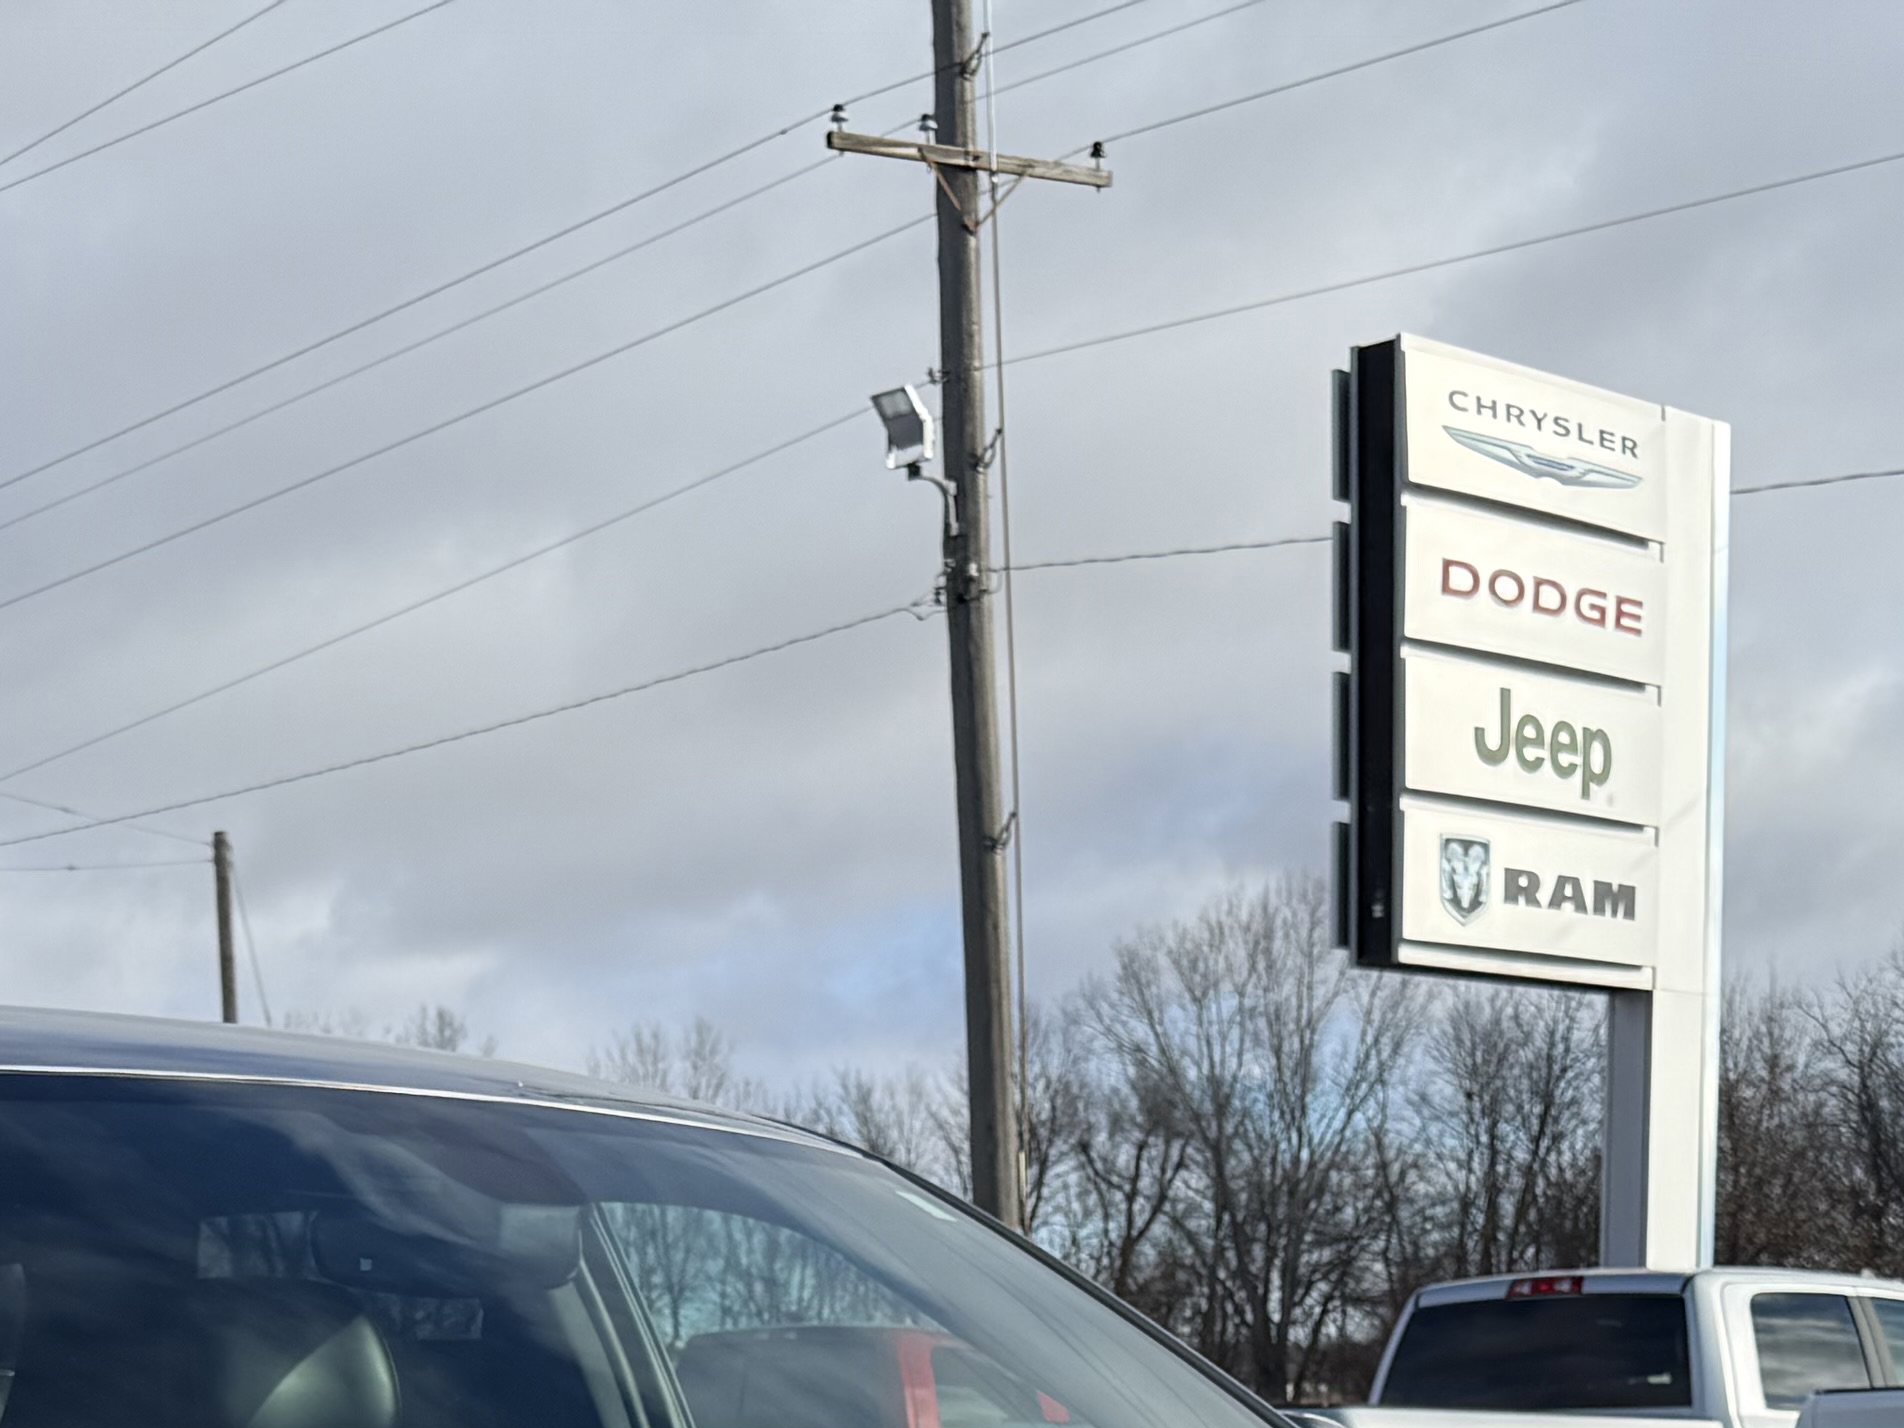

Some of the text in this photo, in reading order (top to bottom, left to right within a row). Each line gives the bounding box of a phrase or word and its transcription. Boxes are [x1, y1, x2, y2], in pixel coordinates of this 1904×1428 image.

[1447, 389, 1639, 459] CHRYSLER
[1441, 557, 1644, 637] DODGE
[1474, 687, 1612, 799] Jeep
[1503, 866, 1637, 921] RAM
